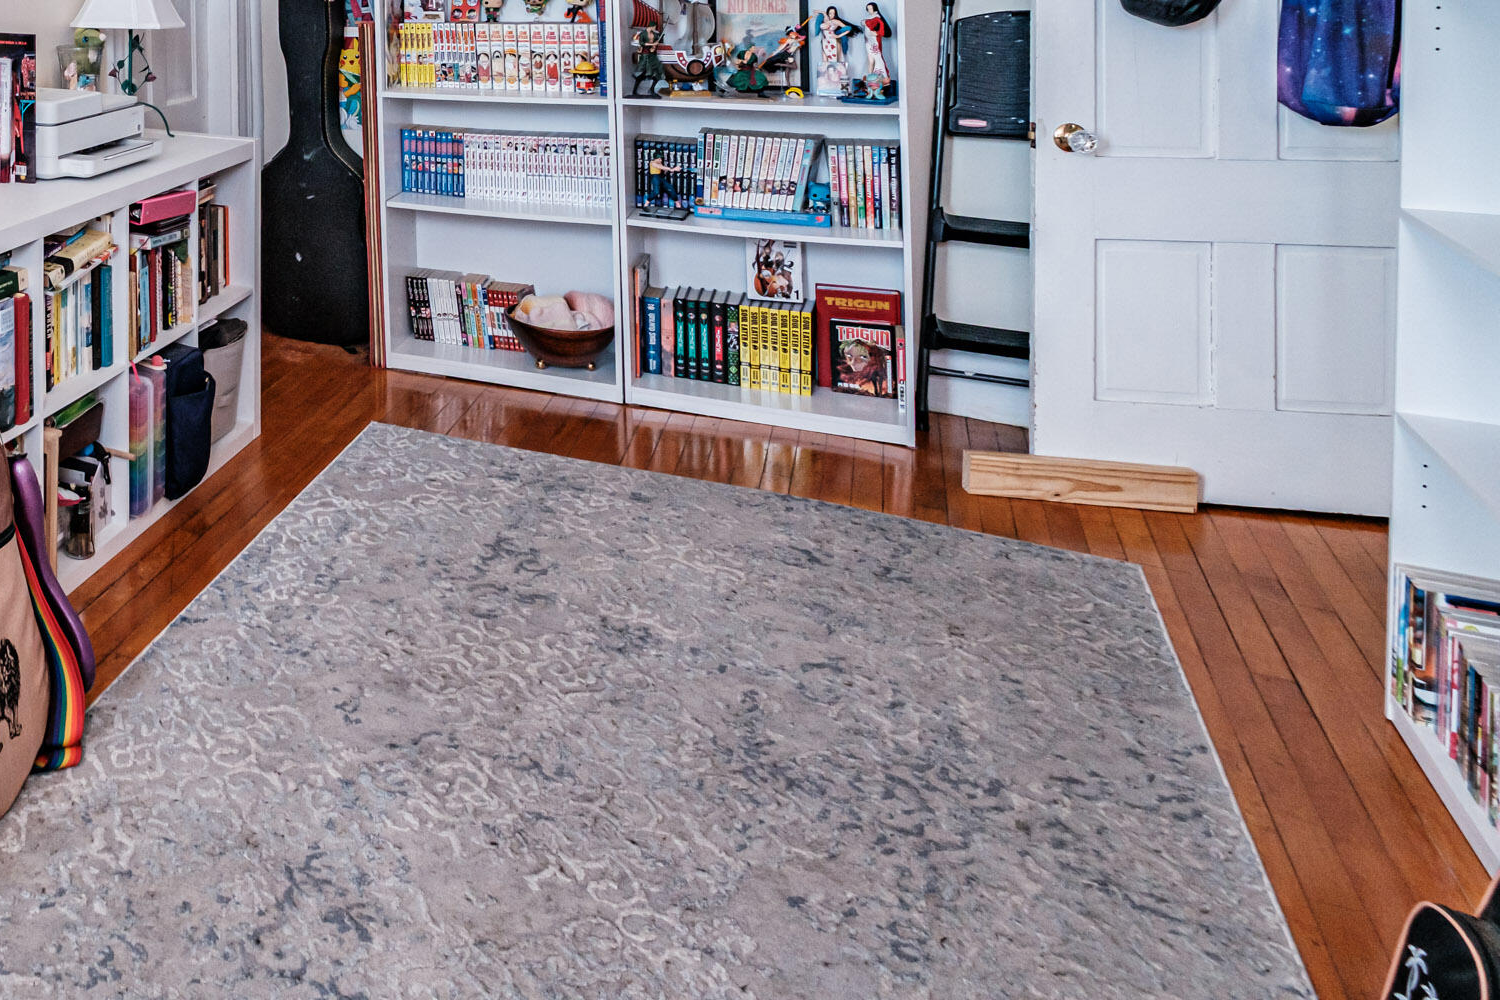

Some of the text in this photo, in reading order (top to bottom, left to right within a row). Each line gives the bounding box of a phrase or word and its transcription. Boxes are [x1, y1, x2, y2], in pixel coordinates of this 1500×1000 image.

[794, 290, 799, 300] 1
[825, 296, 890, 310] TRIGUN
[836, 325, 892, 351] TRIGUN
